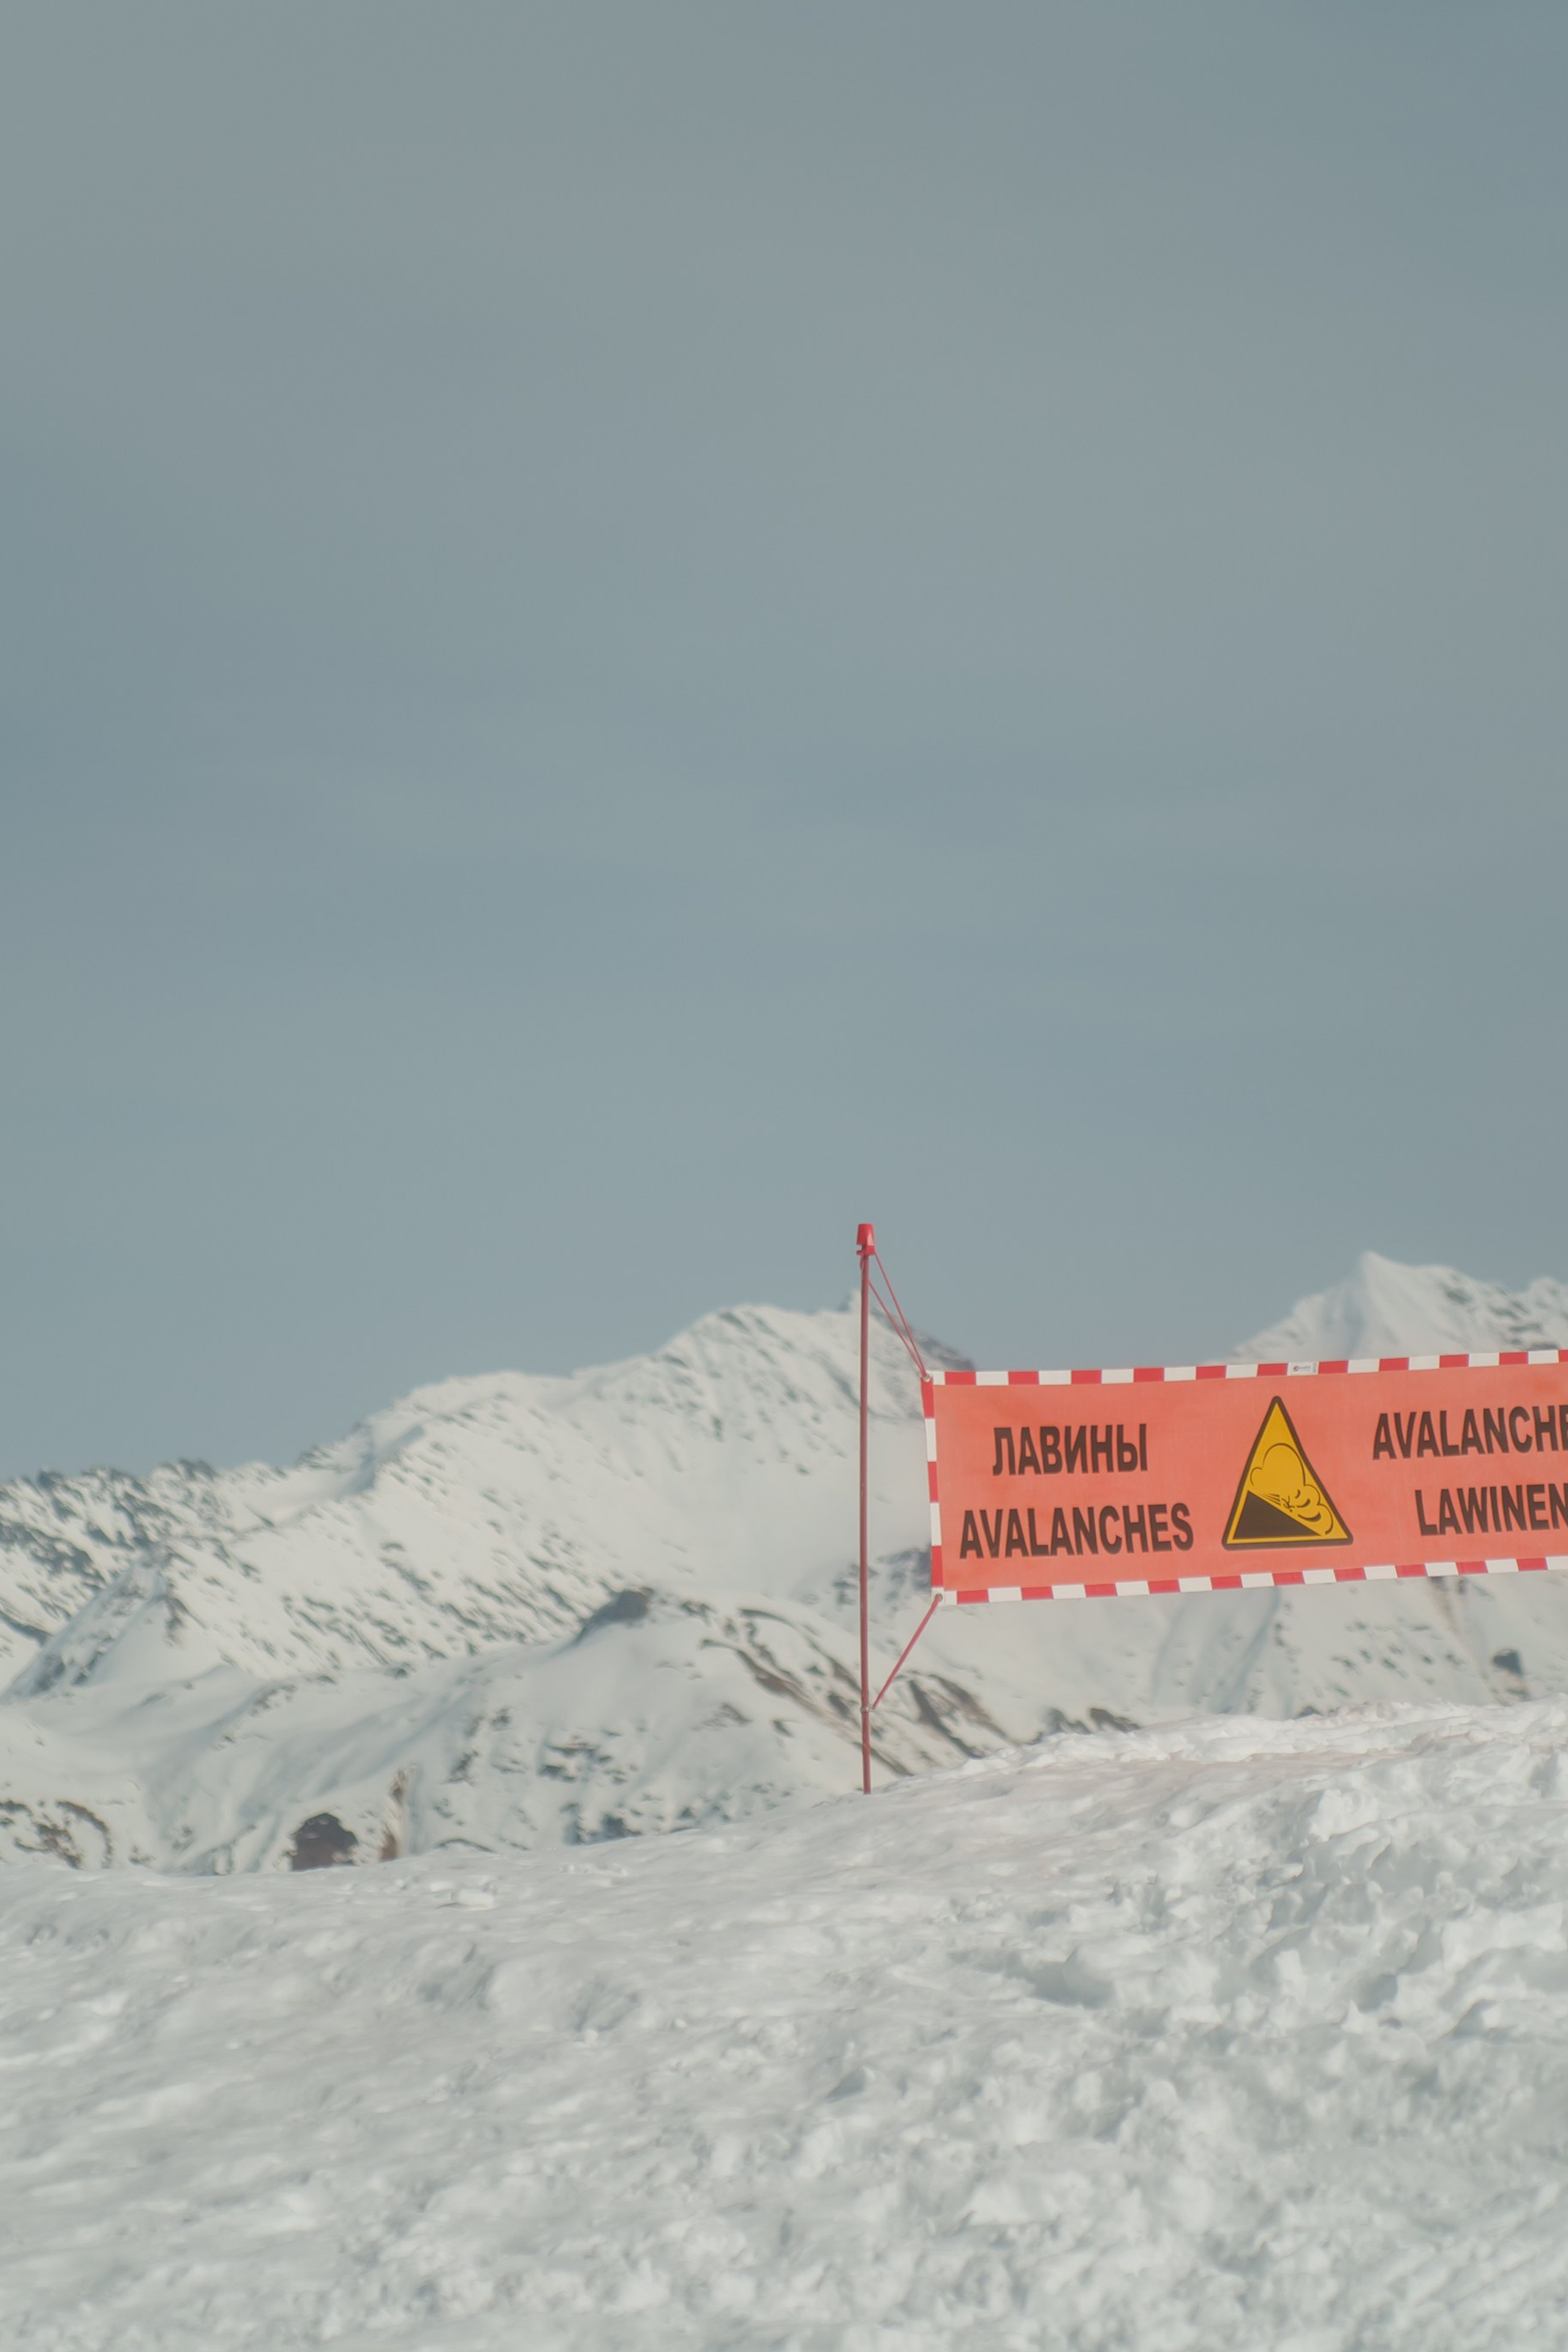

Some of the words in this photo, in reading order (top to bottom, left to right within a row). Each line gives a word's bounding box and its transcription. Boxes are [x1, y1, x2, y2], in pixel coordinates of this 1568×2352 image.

[992, 1423, 1148, 1476] ЛАВИНЫ
[960, 1503, 1194, 1559] AVALANCHES
[1415, 1482, 1568, 1537] LAWINEN
